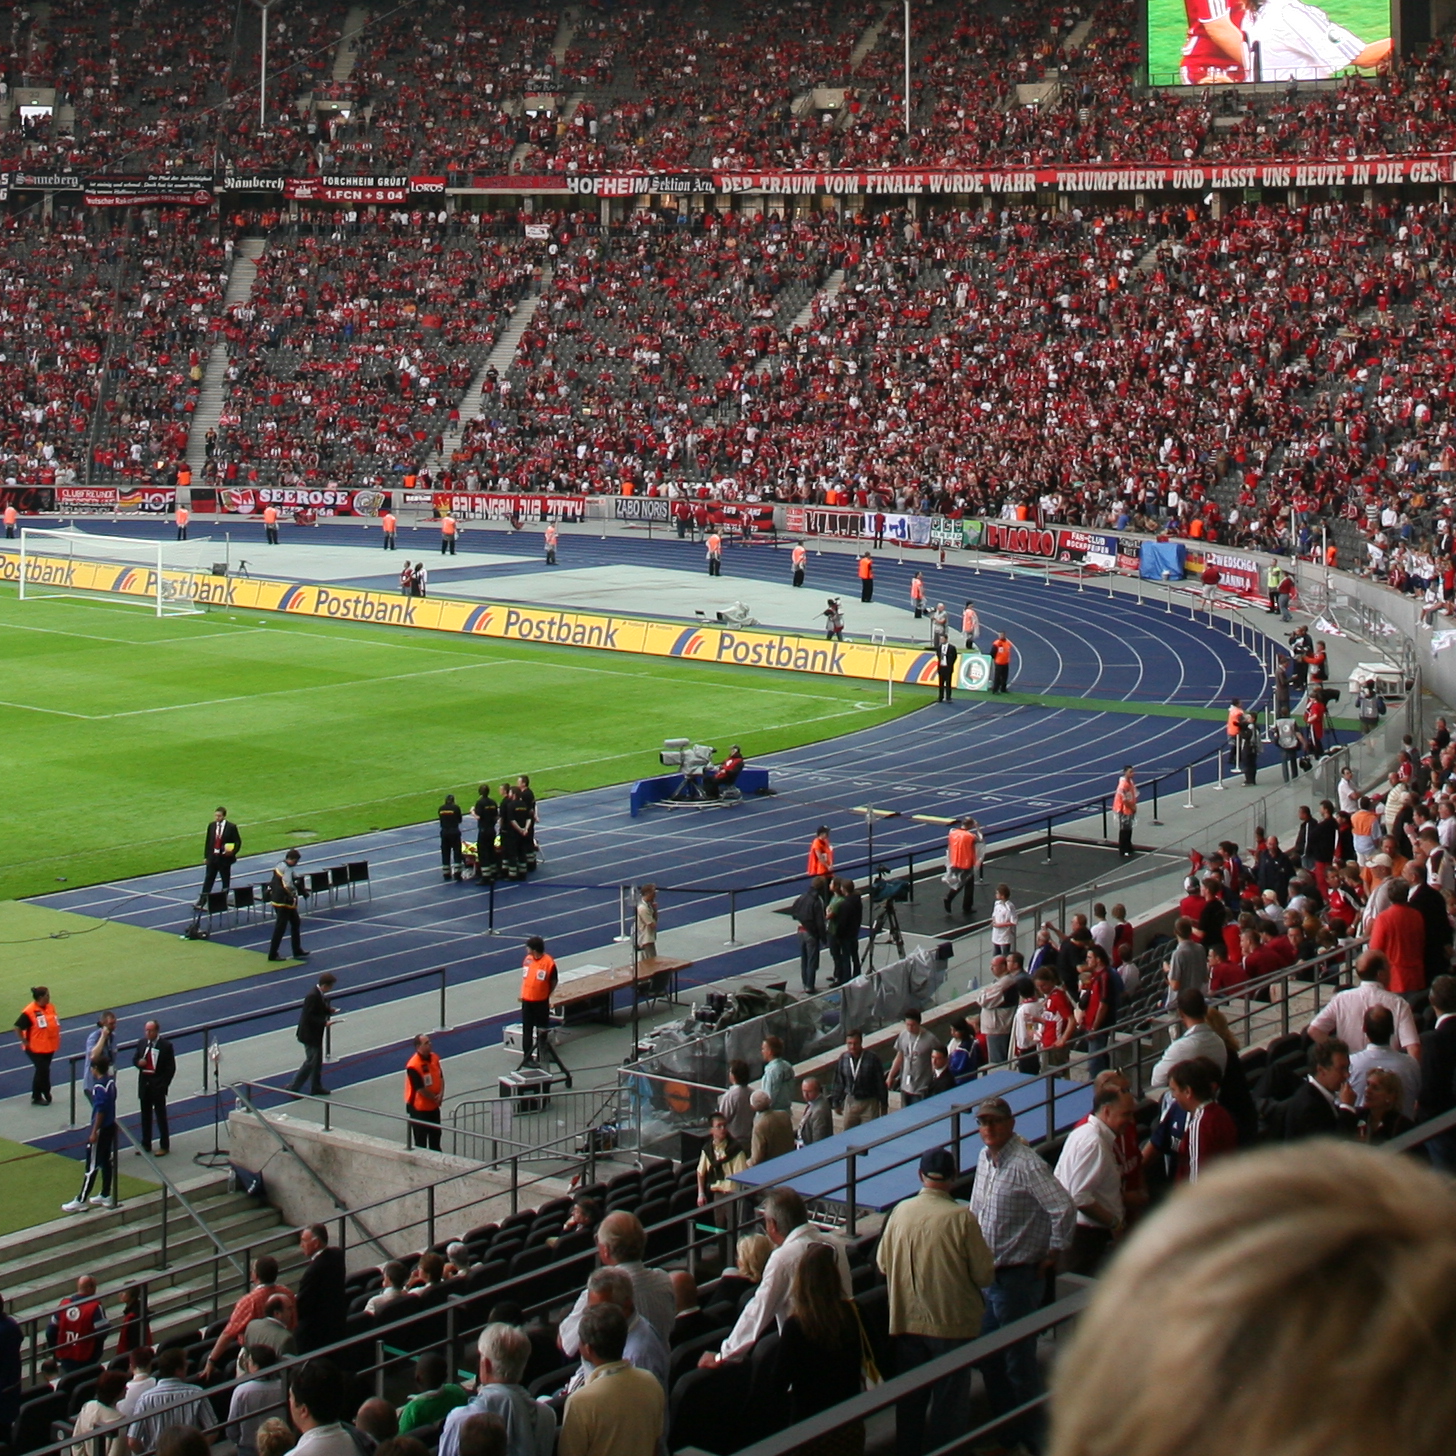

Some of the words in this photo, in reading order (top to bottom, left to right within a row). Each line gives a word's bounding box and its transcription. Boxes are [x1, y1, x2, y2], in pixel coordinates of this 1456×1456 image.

[567, 176, 651, 195] HOFHEIM
[760, 176, 817, 194] TRAUM
[824, 175, 859, 193] VOM
[866, 175, 923, 193] FINALE
[989, 173, 1036, 193] WAHR
[1057, 170, 1166, 192] TRIUMPHIERT
[1172, 169, 1204, 189] UND
[1211, 168, 1256, 188] LASST
[1262, 166, 1291, 187] UNS
[1296, 165, 1345, 186] HEUTE
[1352, 164, 1372, 185] IN
[1376, 162, 1404, 184] DIE
[376, 190, 384, 201] S
[387, 189, 404, 200] 04
[138, 491, 176, 511] HOF
[259, 488, 349, 506] SEEROSE
[616, 499, 641, 518] ZABO
[641, 500, 668, 518] NORIS
[144, 567, 236, 604] Postbank
[314, 587, 417, 626] Postbank
[504, 608, 618, 649] Postbank
[717, 632, 845, 674] Postbank
